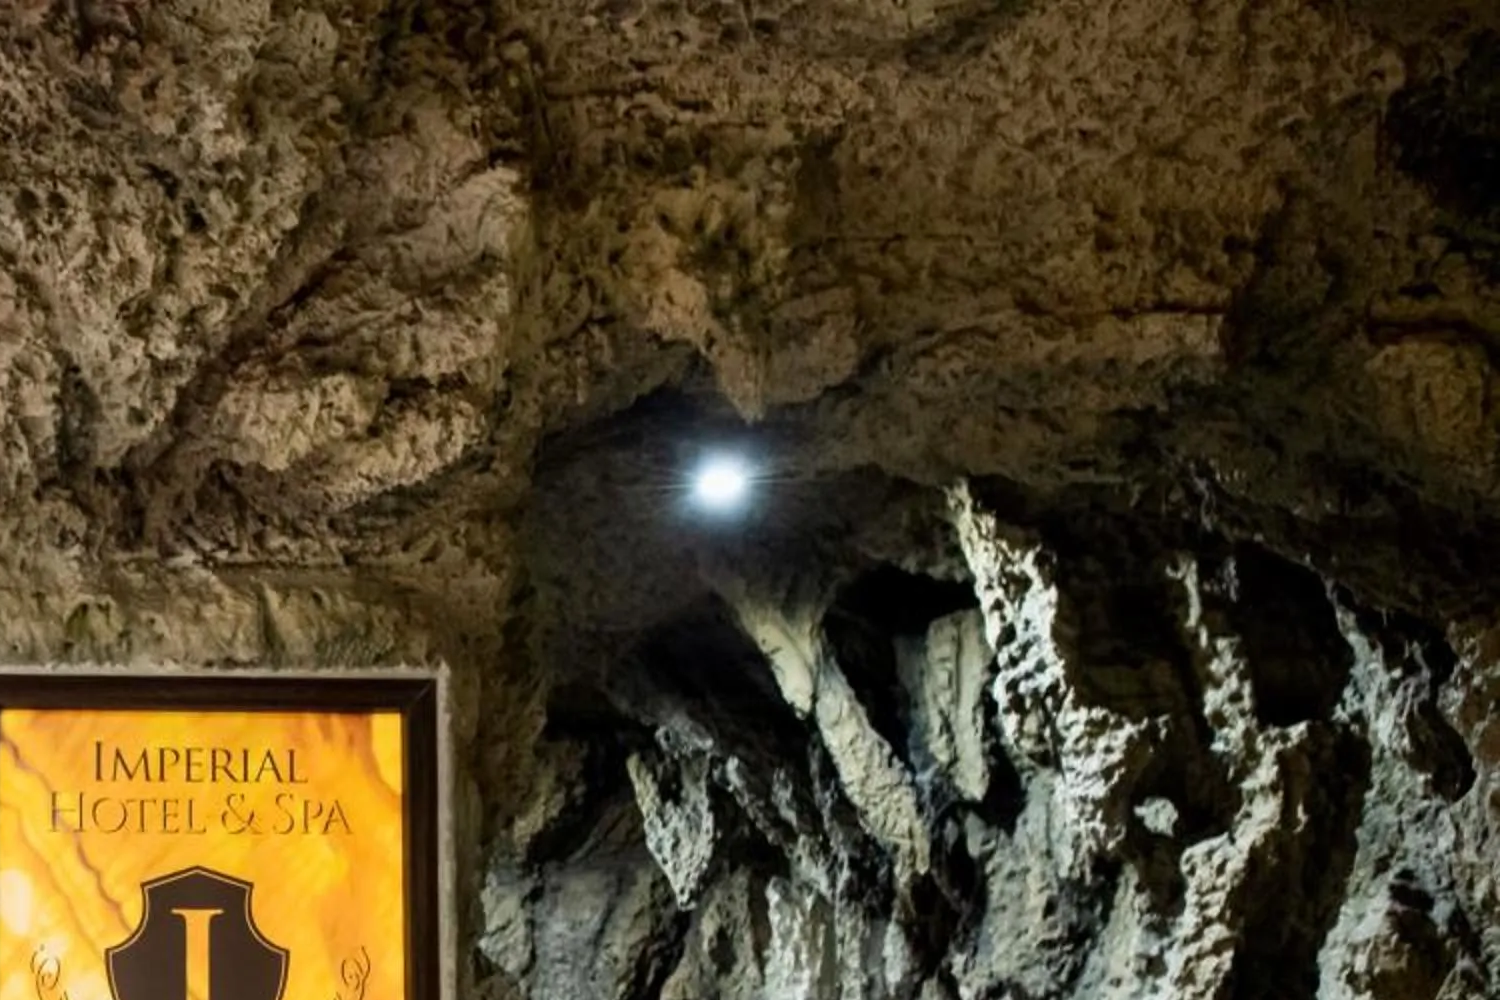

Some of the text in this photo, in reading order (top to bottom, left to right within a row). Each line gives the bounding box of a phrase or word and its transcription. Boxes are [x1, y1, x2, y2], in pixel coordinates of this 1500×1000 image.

[93, 740, 309, 783] IMPERIAL
[47, 791, 353, 836] HOTEL & SPA
